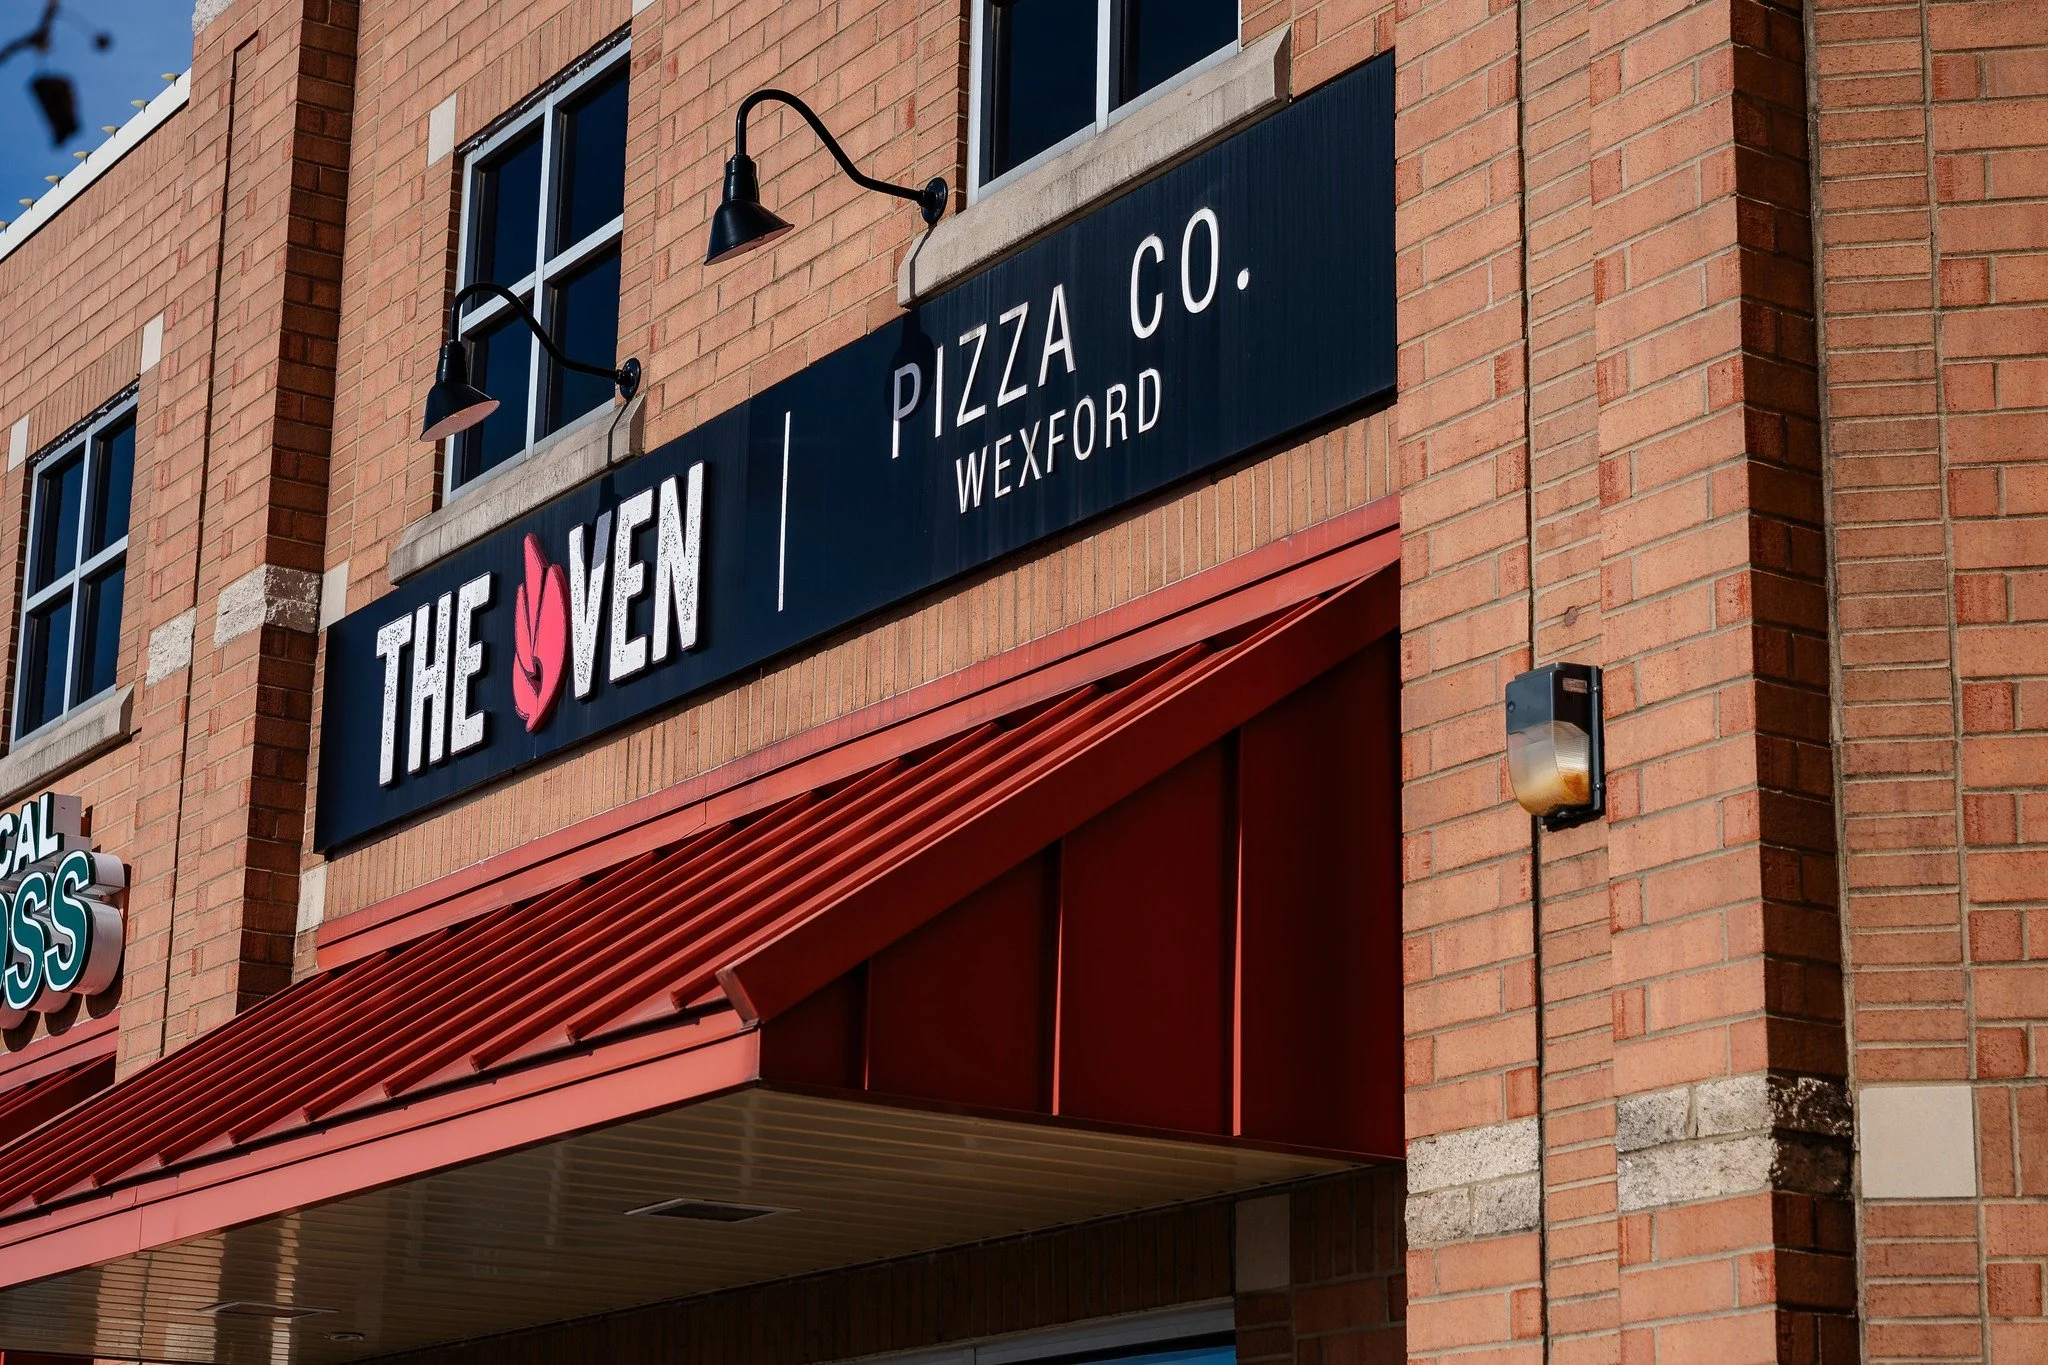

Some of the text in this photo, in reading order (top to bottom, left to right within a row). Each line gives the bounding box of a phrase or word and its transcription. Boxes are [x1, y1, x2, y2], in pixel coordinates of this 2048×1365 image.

[891, 208, 1250, 460] PIZZA CO.
[955, 368, 1162, 514] WEXFORD
[376, 571, 492, 788] THE
[0, 850, 95, 1010] SS
